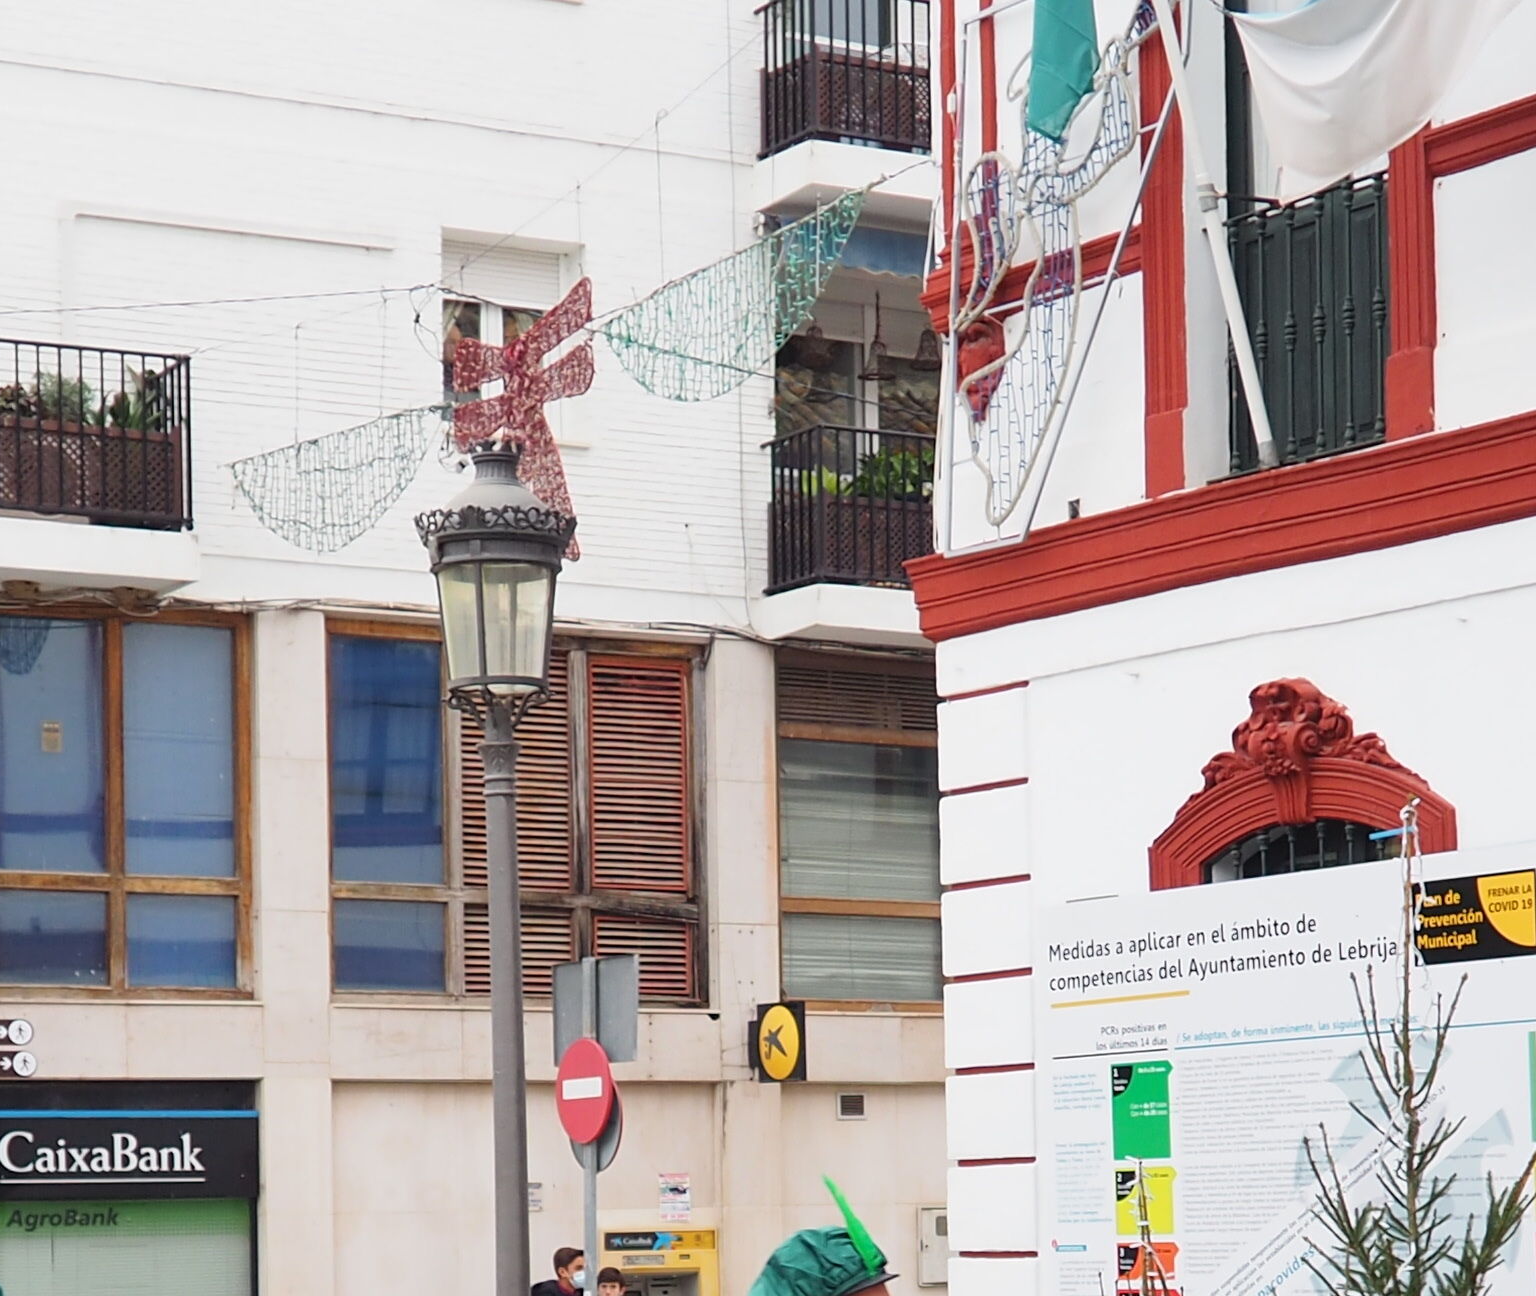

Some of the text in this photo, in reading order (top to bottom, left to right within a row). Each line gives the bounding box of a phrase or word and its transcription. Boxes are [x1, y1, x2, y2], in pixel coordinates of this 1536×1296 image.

[1444, 889, 1461, 905] de
[1488, 884, 1532, 898] FRENAR LA
[1488, 898, 1533, 914] COVID 19
[1417, 909, 1484, 929] Prevención
[1049, 913, 1317, 962] Medidas a aplicar en el ámbito de
[1416, 930, 1478, 949] Municipal
[1049, 936, 1398, 993] competencias del Ayuntamiento de Lebrija
[1121, 1023, 1155, 1035] positivas
[7, 1207, 119, 1232] AgroBank
